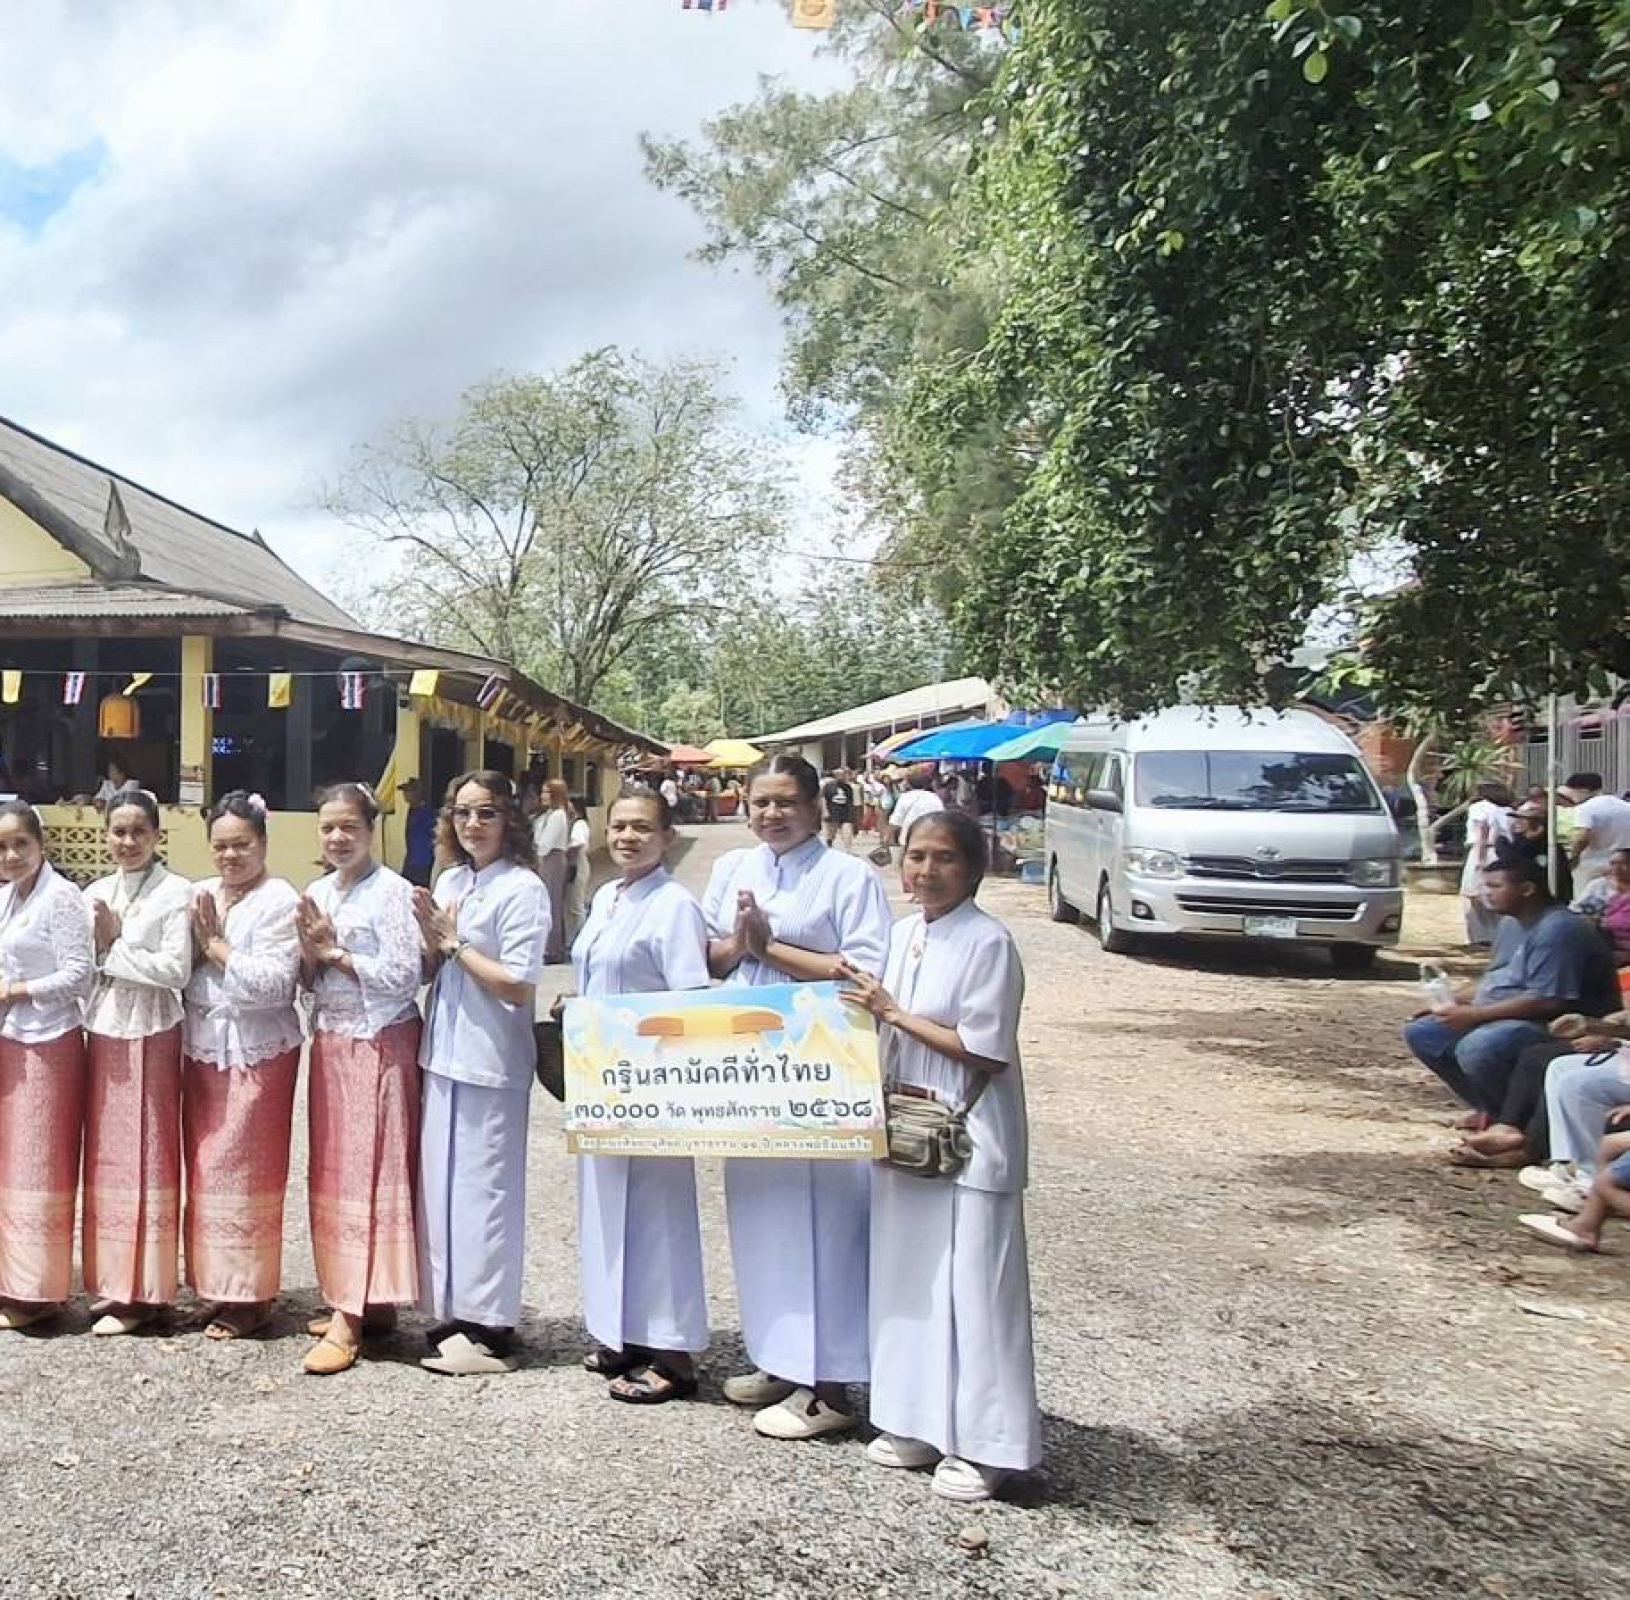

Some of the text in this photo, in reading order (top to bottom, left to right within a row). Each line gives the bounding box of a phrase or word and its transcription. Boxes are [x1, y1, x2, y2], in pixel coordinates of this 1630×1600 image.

[602, 1047, 831, 1093] กฐินสามัคคีทั่วไทย
[574, 1102, 660, 1121] ๓๐,๐๐๐
[788, 1098, 873, 1117] ๒๕๖๘
